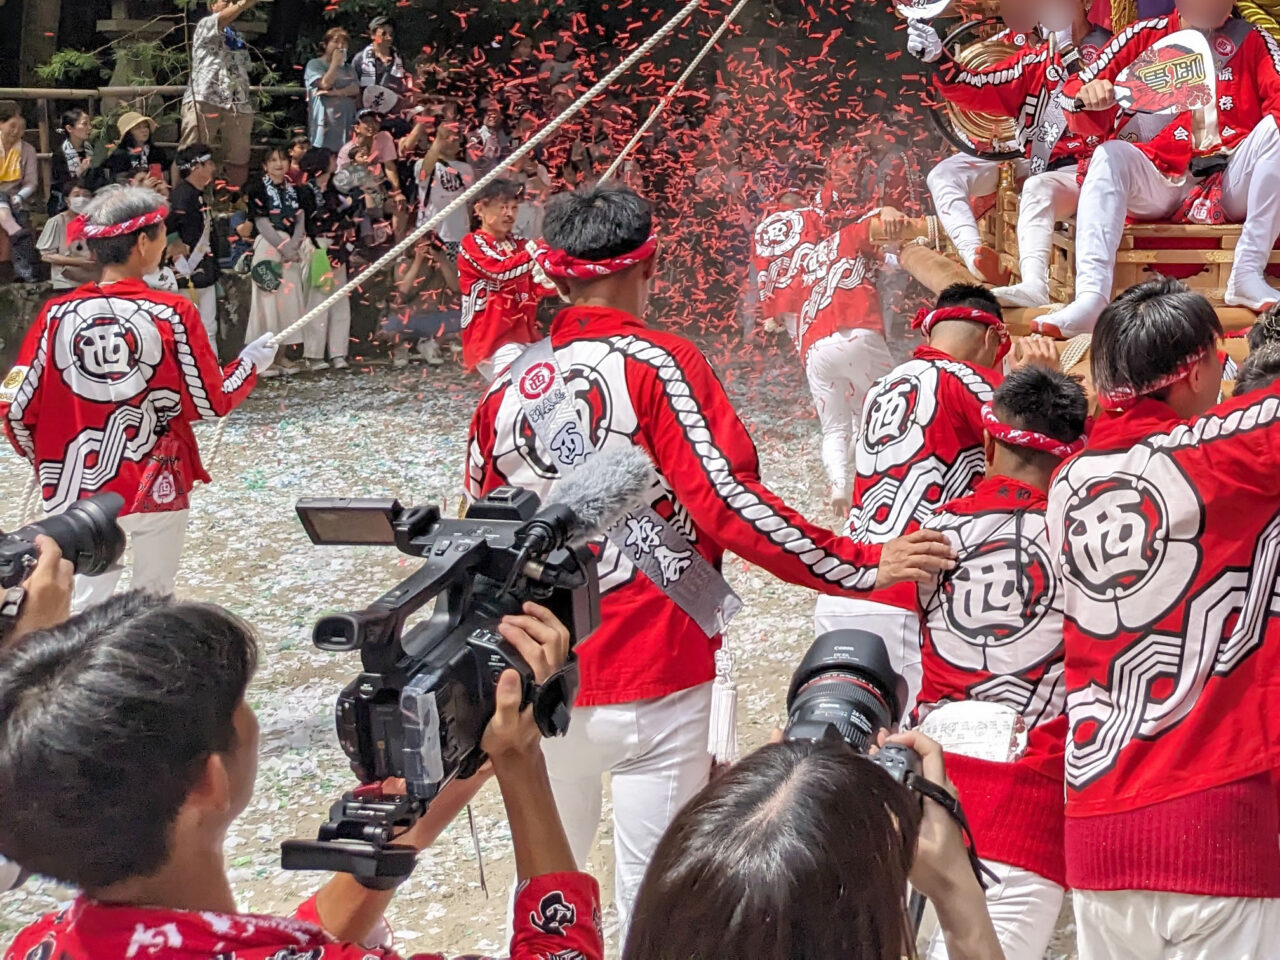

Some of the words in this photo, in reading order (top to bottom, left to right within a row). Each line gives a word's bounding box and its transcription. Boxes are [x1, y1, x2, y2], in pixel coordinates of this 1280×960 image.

[80, 324, 131, 374] 西
[528, 370, 546, 390] 西
[868, 387, 907, 438] 西
[1068, 488, 1148, 584] 西
[950, 554, 1026, 629] 西
